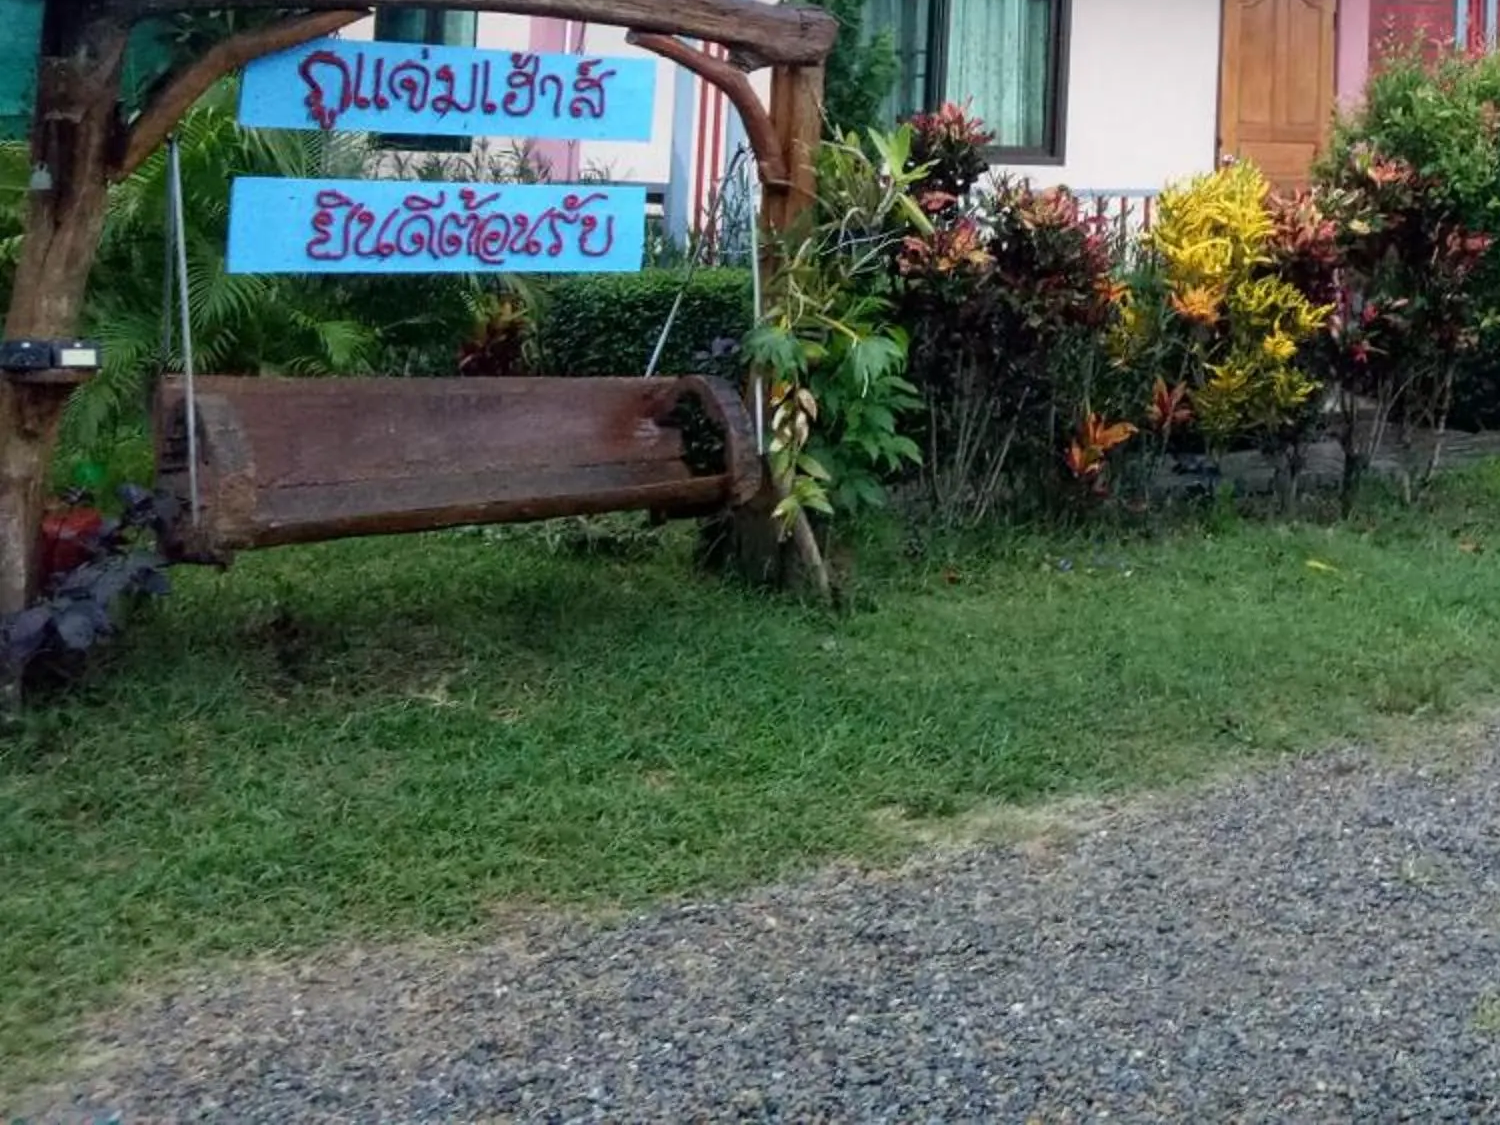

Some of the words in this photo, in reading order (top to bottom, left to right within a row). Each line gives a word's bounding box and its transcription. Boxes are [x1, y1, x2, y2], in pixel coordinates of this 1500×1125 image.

[305, 187, 614, 265] ยินดีต้อนรับ
